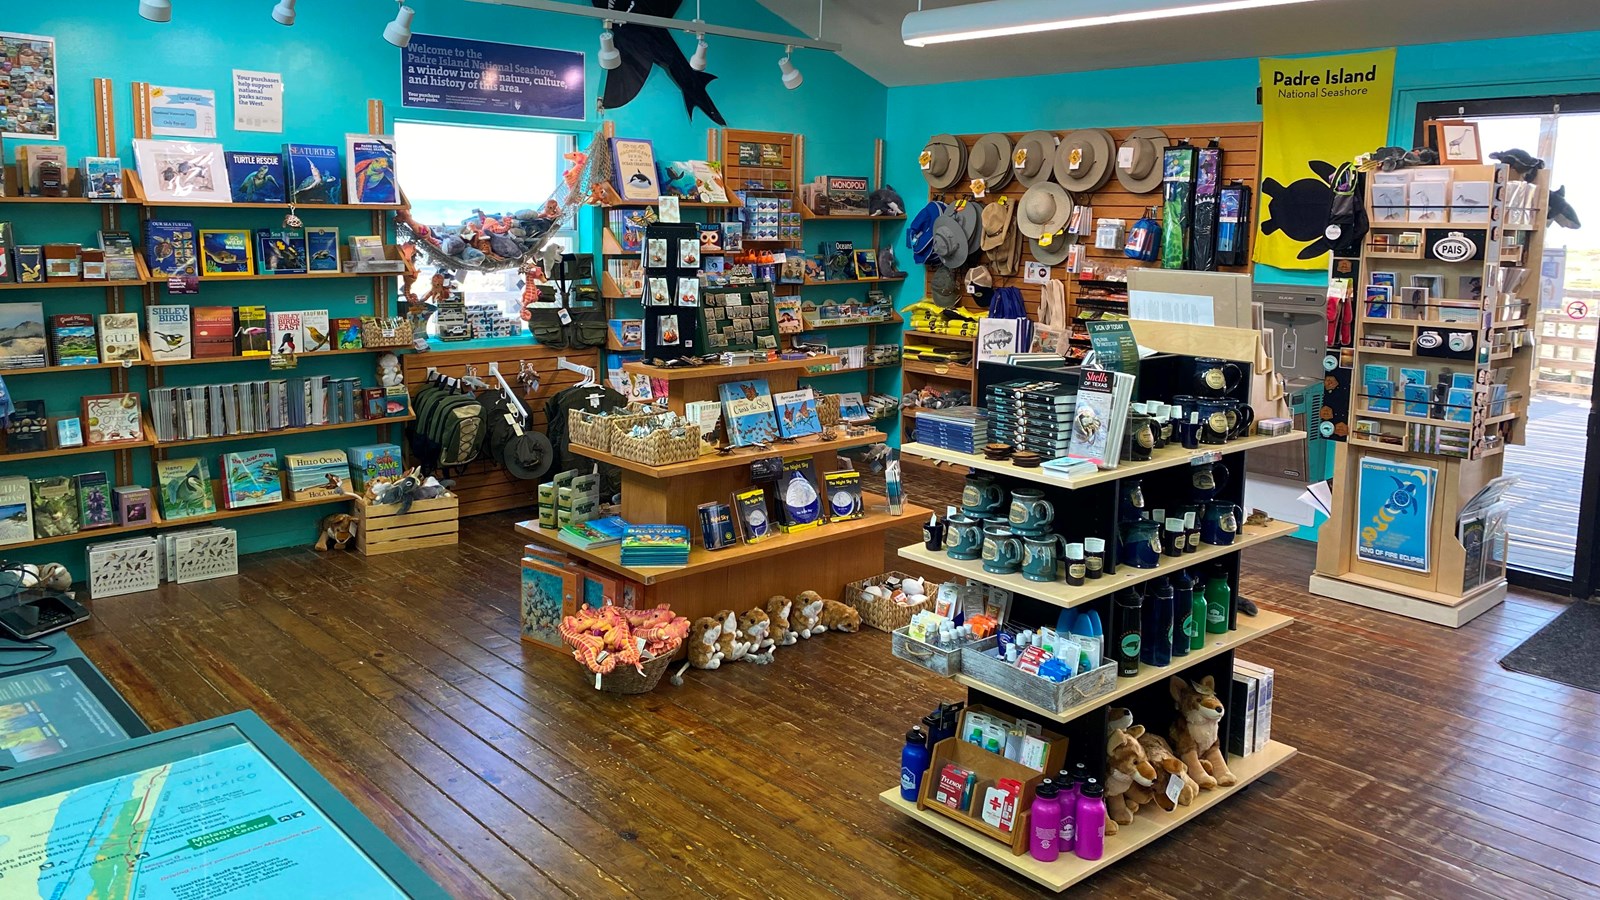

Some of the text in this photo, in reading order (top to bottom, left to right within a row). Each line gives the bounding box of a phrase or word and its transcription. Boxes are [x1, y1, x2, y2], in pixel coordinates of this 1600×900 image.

[408, 43, 482, 59] Welcome to the
[408, 54, 557, 78] Padre Island National Seashore,
[251, 76, 280, 84] purchases
[408, 66, 568, 89] a window into the nature, culture,
[1274, 65, 1376, 86] Padre Island
[408, 76, 522, 94] and history of this area.
[1278, 86, 1368, 98] National Seashore
[234, 156, 278, 166] TURTLE RESCUE
[832, 181, 866, 190] MONOPOLY
[1442, 245, 1463, 255] PAIS
[105, 334, 138, 342] GULF
[1085, 371, 1108, 383] Shells
[734, 405, 749, 414] Cross
[758, 399, 769, 410] Sky
[296, 456, 342, 466] HELLO OCEAN
[379, 461, 399, 470] SAVE
[1385, 550, 1398, 559] FIRE
[1400, 552, 1425, 565] ECLIPSE
[184, 762, 254, 786] GULF OF
[941, 775, 962, 789] TYLENOL
[197, 772, 256, 794] MEXICO
[150, 824, 198, 840] Malaquite
[192, 823, 246, 844] Malaquite
[195, 821, 269, 848] Visitor Center
[18, 839, 79, 860] Nature Trail
[160, 869, 189, 881] Driving
[214, 849, 251, 863] permitted
[264, 833, 300, 847] Malaquite
[301, 826, 322, 834] Beach
[10, 856, 42, 869] Island
[46, 847, 74, 858] Basin
[276, 859, 292, 868] high
[37, 852, 123, 881] Park Headquarters
[171, 876, 211, 890] Primitive
[233, 860, 258, 870] Beach
[173, 856, 279, 894] From here south, conditions
[191, 880, 222, 893] suitable
[223, 882, 239, 890] soft
